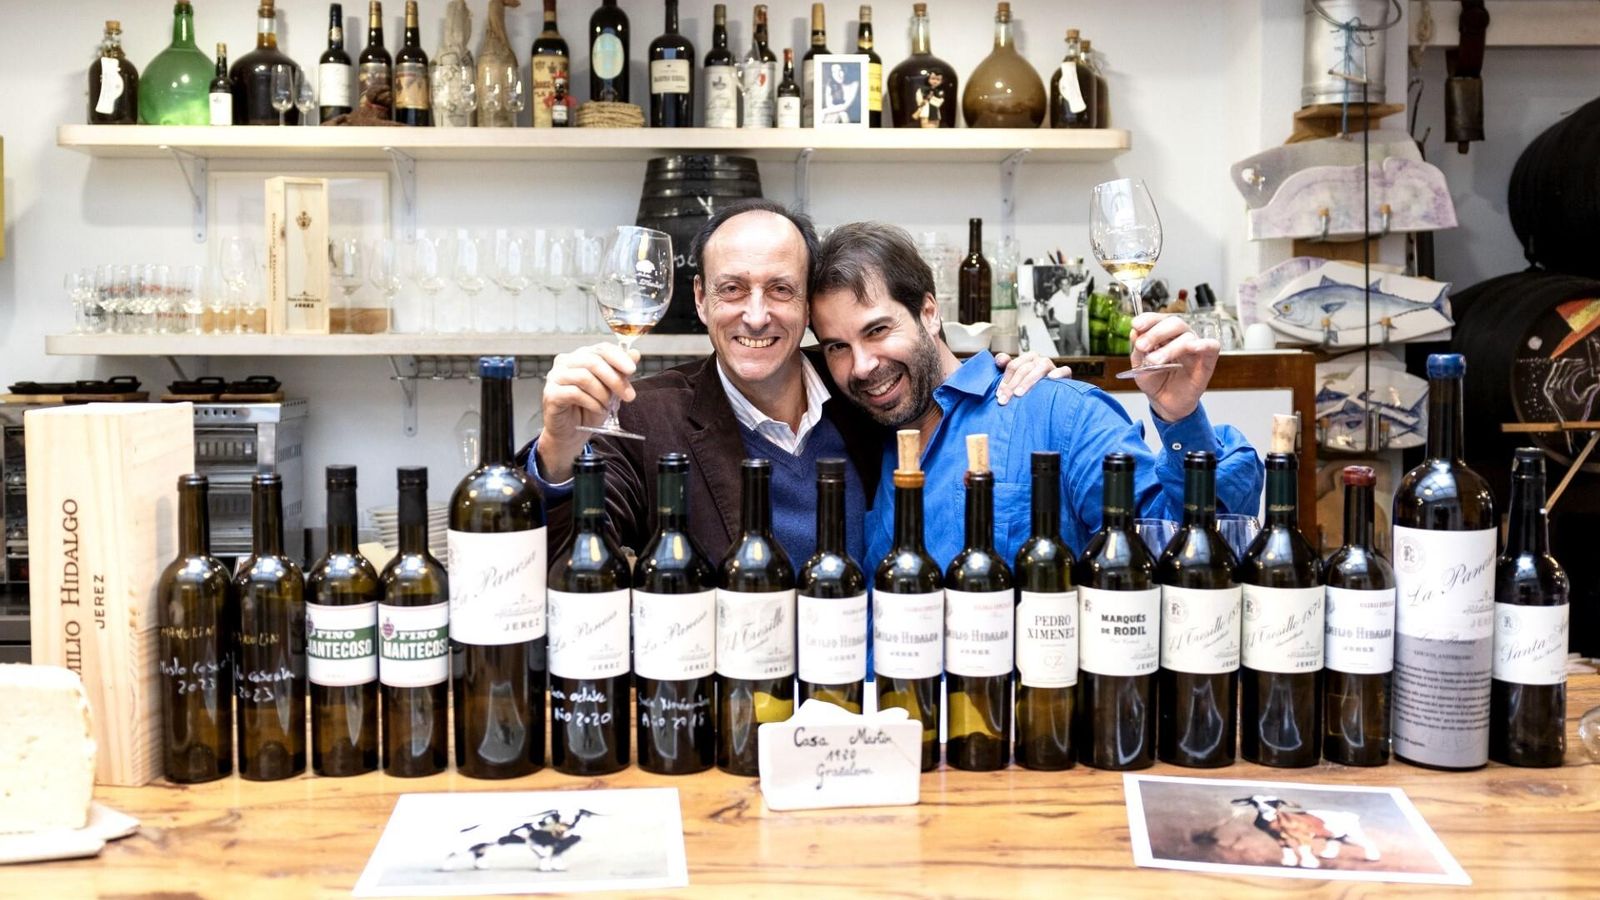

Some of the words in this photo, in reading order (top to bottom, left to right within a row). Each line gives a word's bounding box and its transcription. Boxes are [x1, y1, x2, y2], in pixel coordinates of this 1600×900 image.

[61, 499, 80, 607] HIDALGO
[94, 574, 105, 630] JEREZ
[1407, 585, 1432, 607] La
[503, 617, 541, 632] JEREZ
[1034, 614, 1072, 627] PEDRO
[1101, 613, 1147, 625] MARQUÉS
[316, 630, 356, 640] FINO
[398, 630, 439, 640] FINO
[1027, 627, 1076, 641] XIMENEZ
[1113, 626, 1147, 637] RODIL
[65, 620, 82, 682] MILIO
[239, 687, 275, 703] 2023
[576, 712, 613, 728] 2020
[793, 726, 830, 748] Casa
